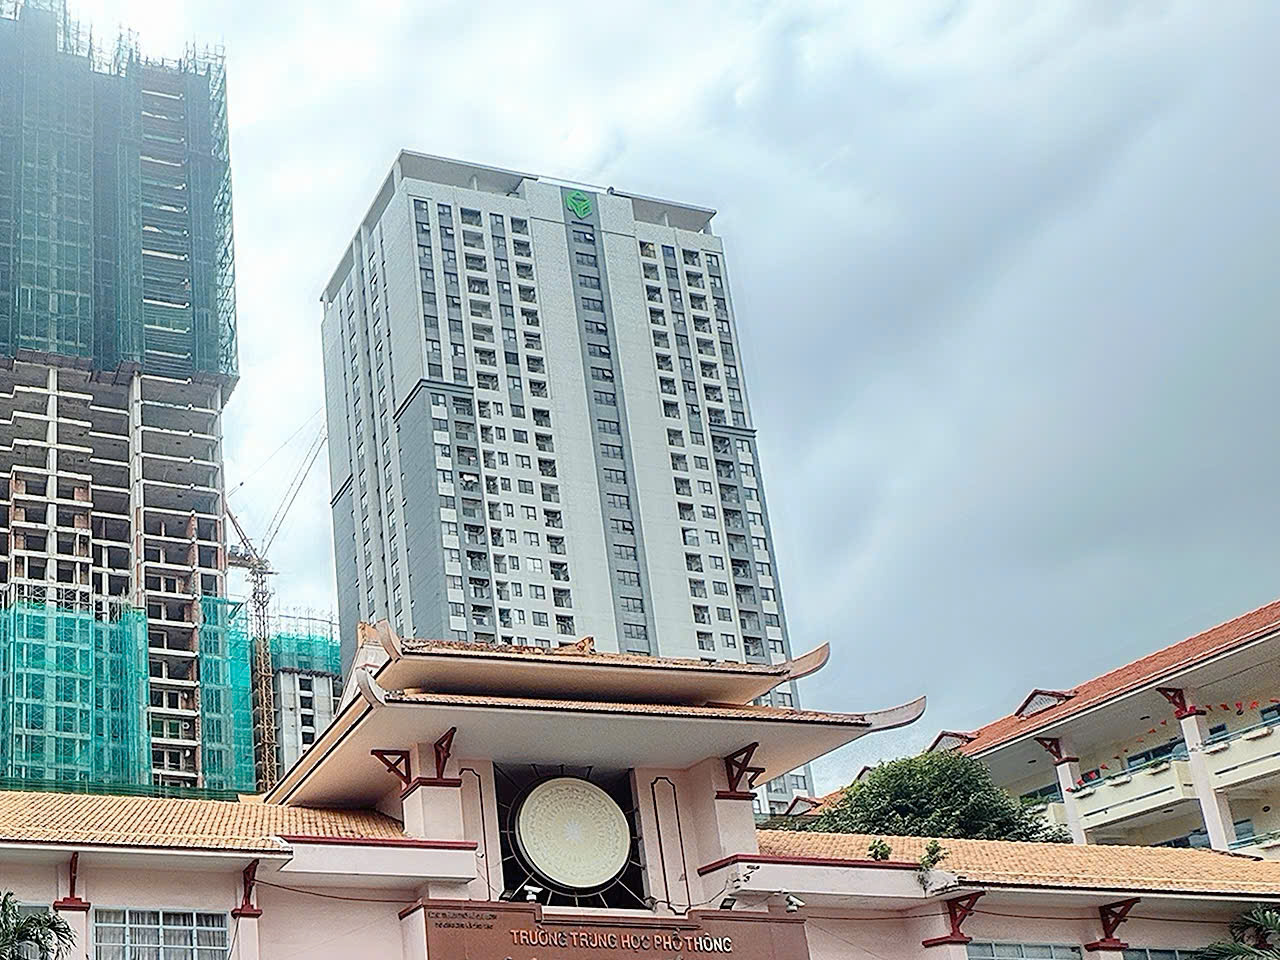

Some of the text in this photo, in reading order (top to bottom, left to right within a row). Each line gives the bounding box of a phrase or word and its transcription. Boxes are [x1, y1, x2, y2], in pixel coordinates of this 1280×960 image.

[510, 925, 734, 954] TRƯỜNG TRUNG HỌC PHỔ THÔNG
